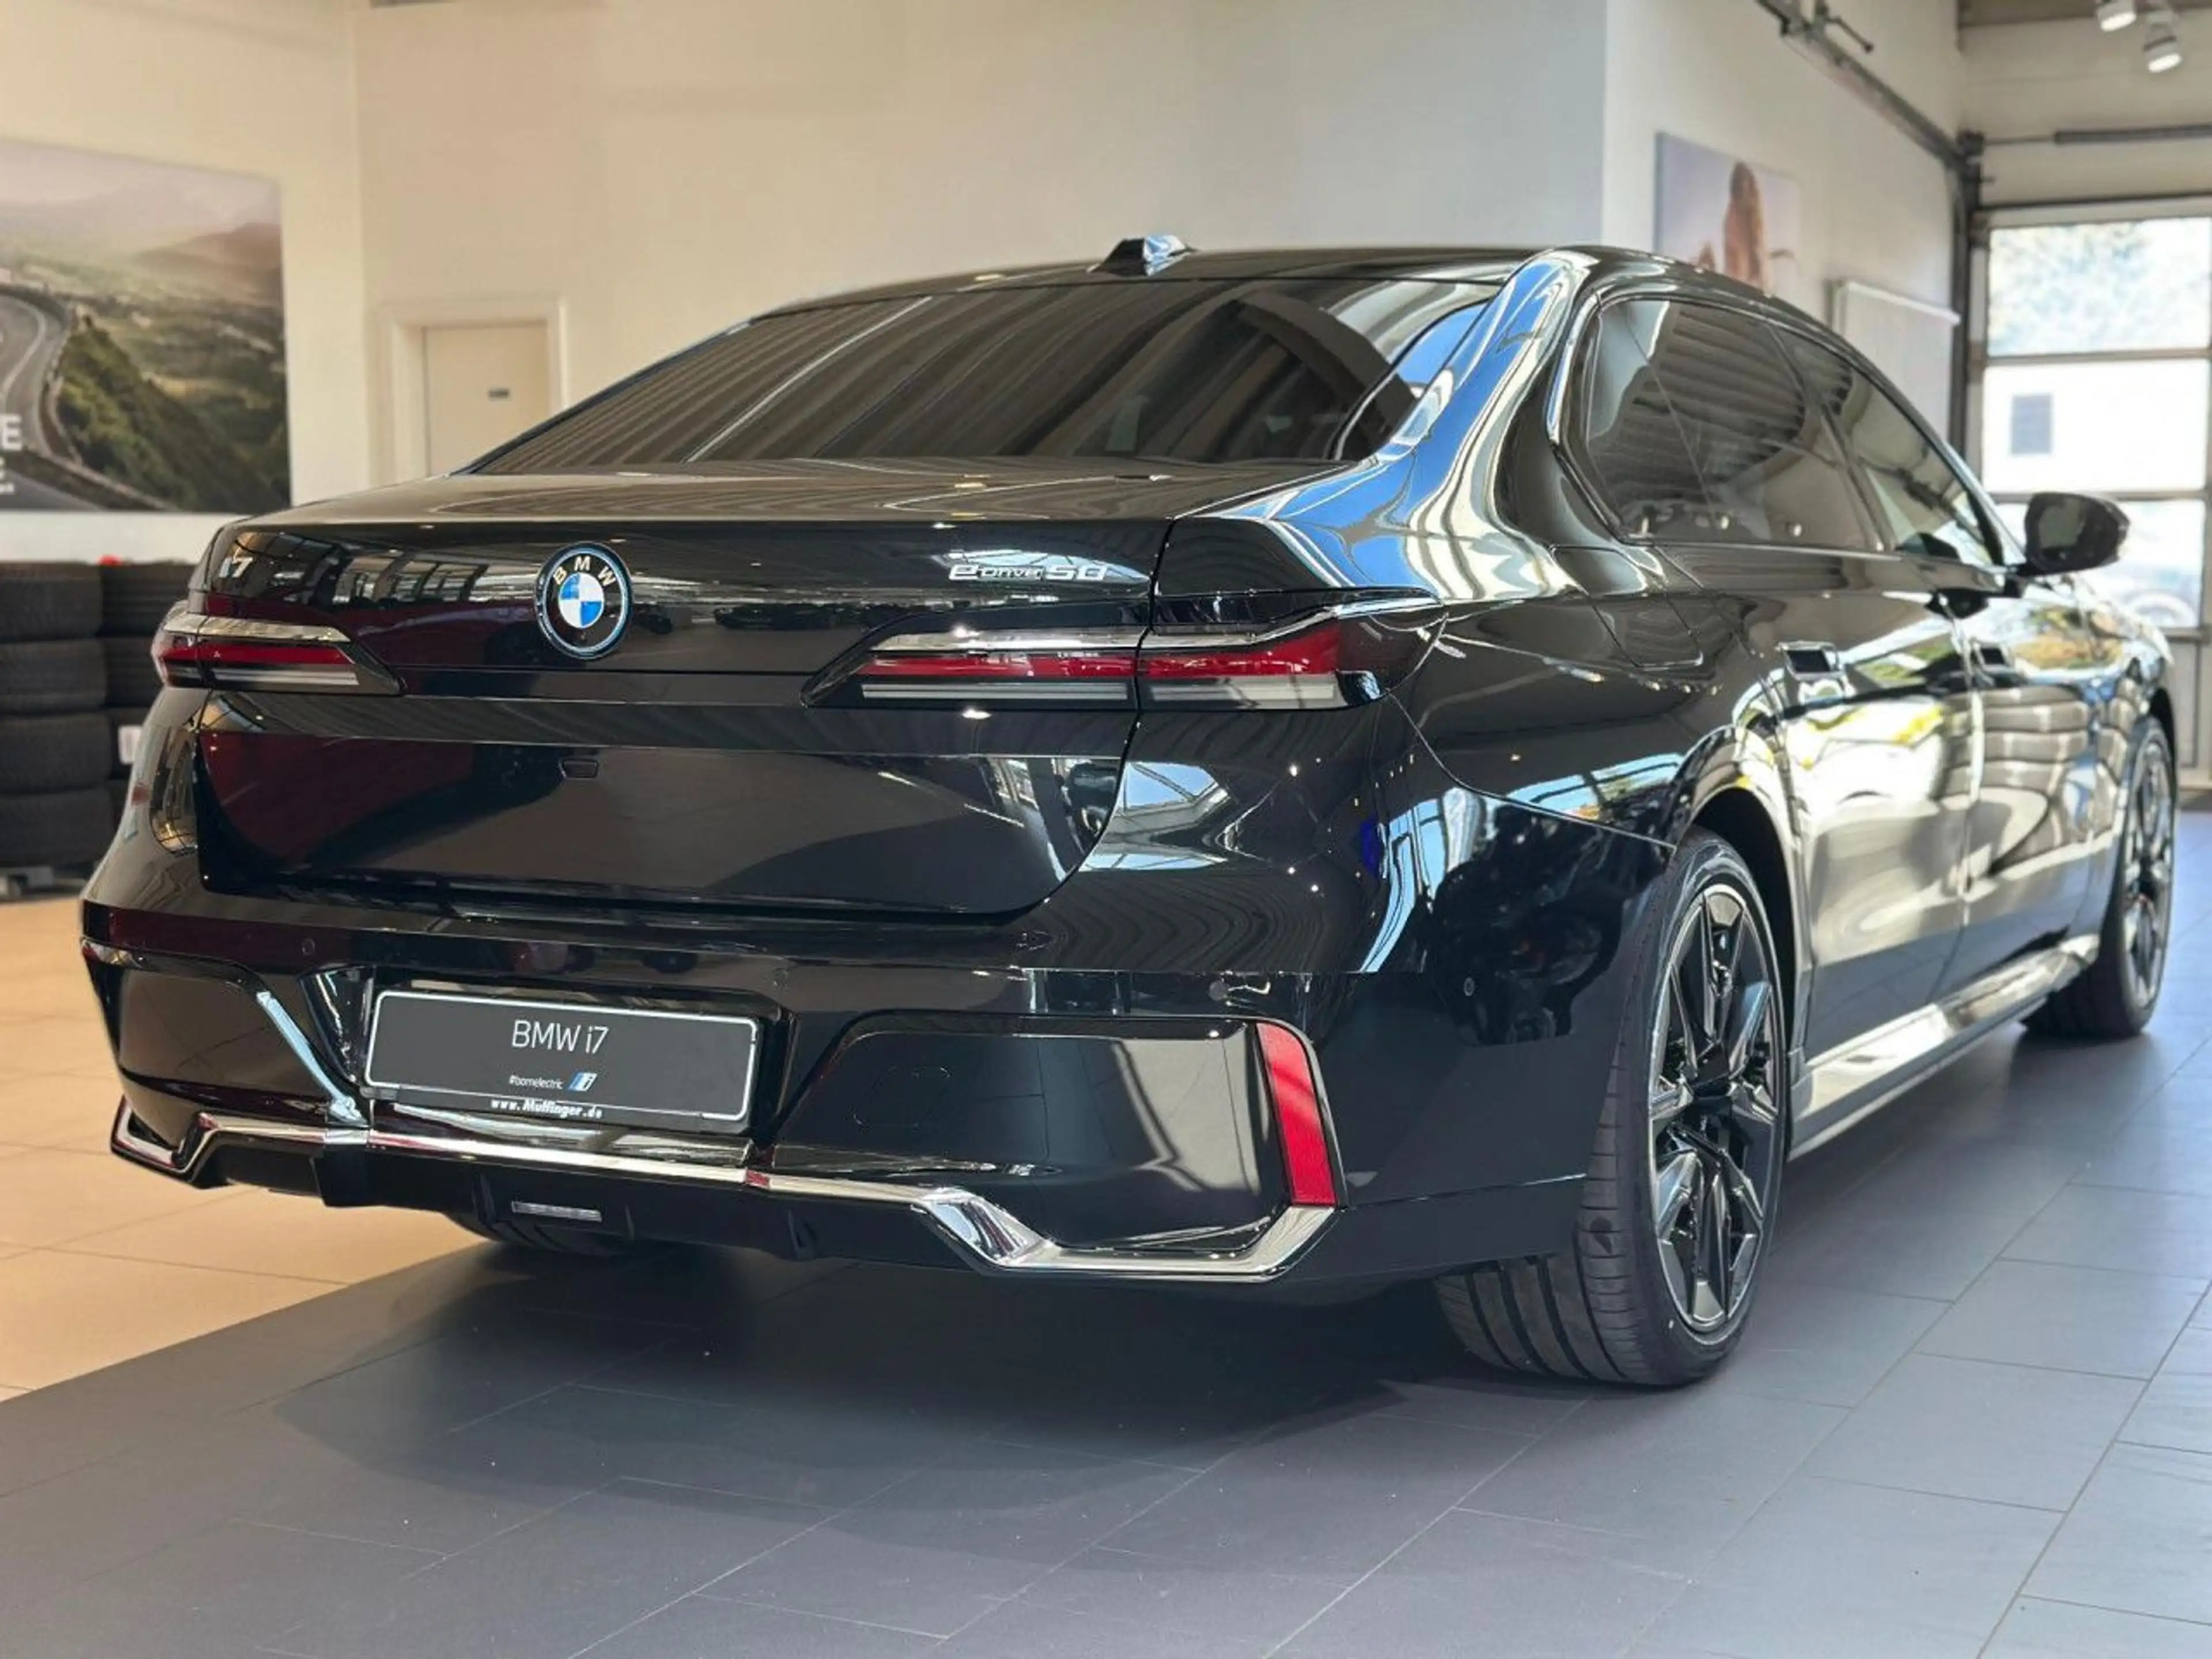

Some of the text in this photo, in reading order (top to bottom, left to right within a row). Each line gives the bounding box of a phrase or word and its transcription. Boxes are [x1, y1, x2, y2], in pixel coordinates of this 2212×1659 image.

[553, 556, 616, 586] BMW
[512, 1019, 609, 1054] BMW i7
